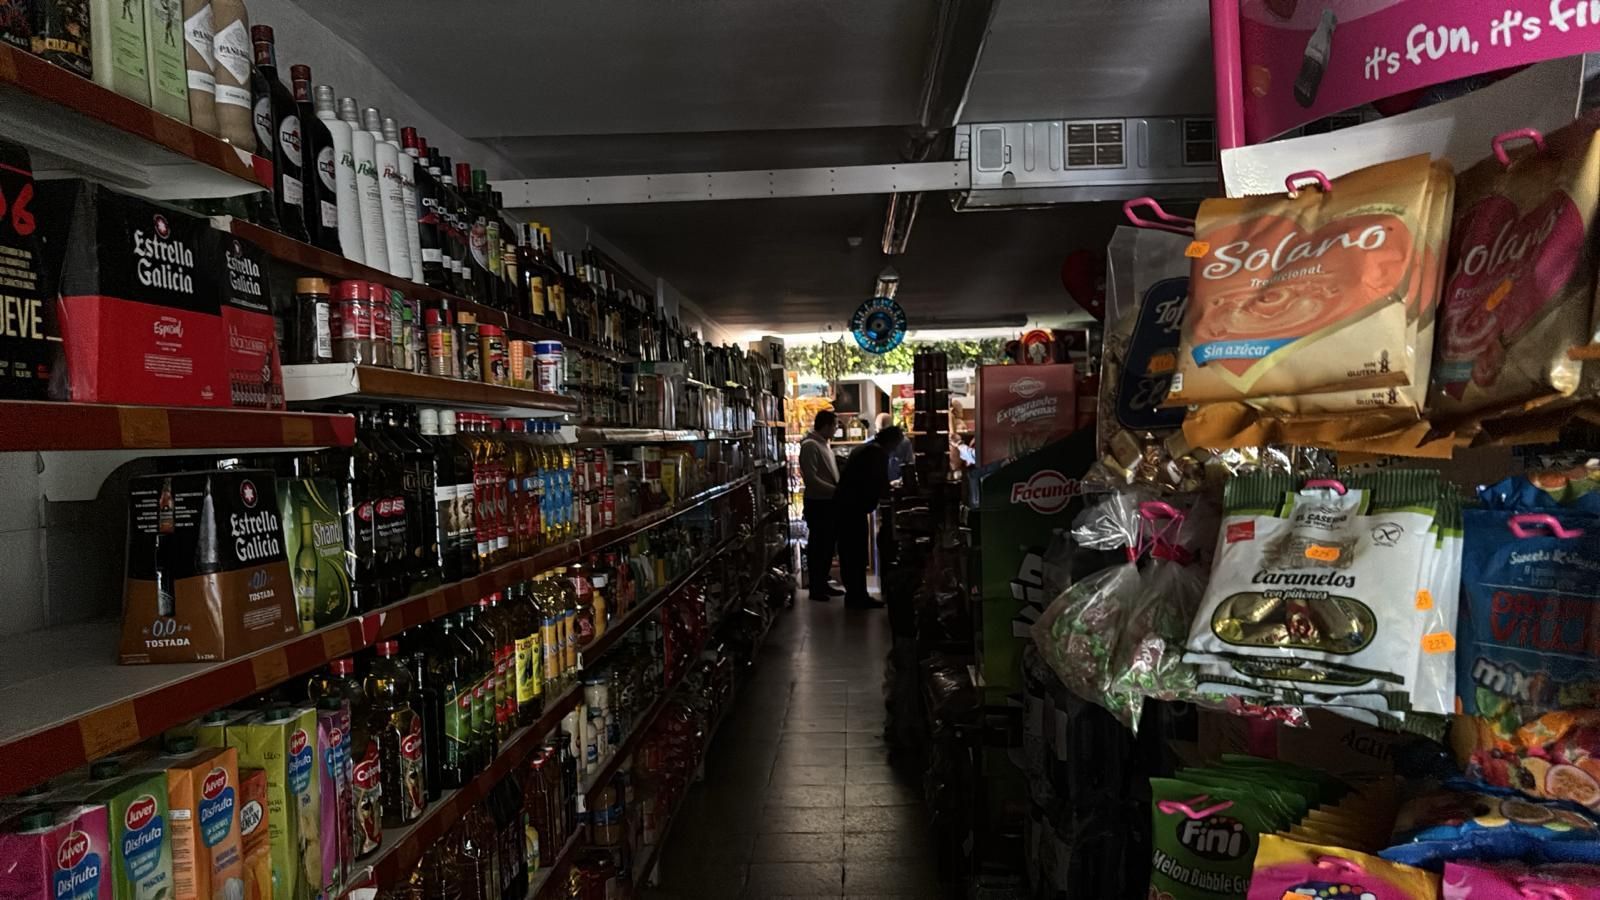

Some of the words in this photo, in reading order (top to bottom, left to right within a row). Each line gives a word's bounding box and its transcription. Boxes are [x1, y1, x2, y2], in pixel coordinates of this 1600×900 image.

[1365, 46, 1400, 81] it's
[1490, 9, 1542, 47] it's
[133, 229, 194, 269] Estrella
[1202, 225, 1386, 280] Solano
[137, 257, 194, 295] Galicia
[225, 248, 261, 278] Estrella
[1250, 264, 1322, 288] Tradicional
[229, 269, 262, 296] Galicia
[1203, 343, 1223, 358] Sin
[1225, 343, 1271, 357] azúcar
[1010, 478, 1082, 504] Facundo
[229, 510, 279, 537] Estrella
[235, 533, 281, 562] Galicia
[1251, 568, 1356, 588] Caramelos
[248, 589, 275, 602] TOSTADA
[1263, 588, 1283, 598] con
[145, 637, 191, 648] TOSTADA
[203, 775, 224, 794] Juver
[127, 804, 154, 825] Juver
[200, 797, 232, 824] Disfruta
[61, 840, 86, 862] Juver
[124, 827, 162, 856] Disfruta
[1181, 820, 1244, 857] Fini
[57, 865, 99, 897] Disfruta
[1151, 849, 1191, 883] Melon
[1189, 868, 1235, 894] Bubble
